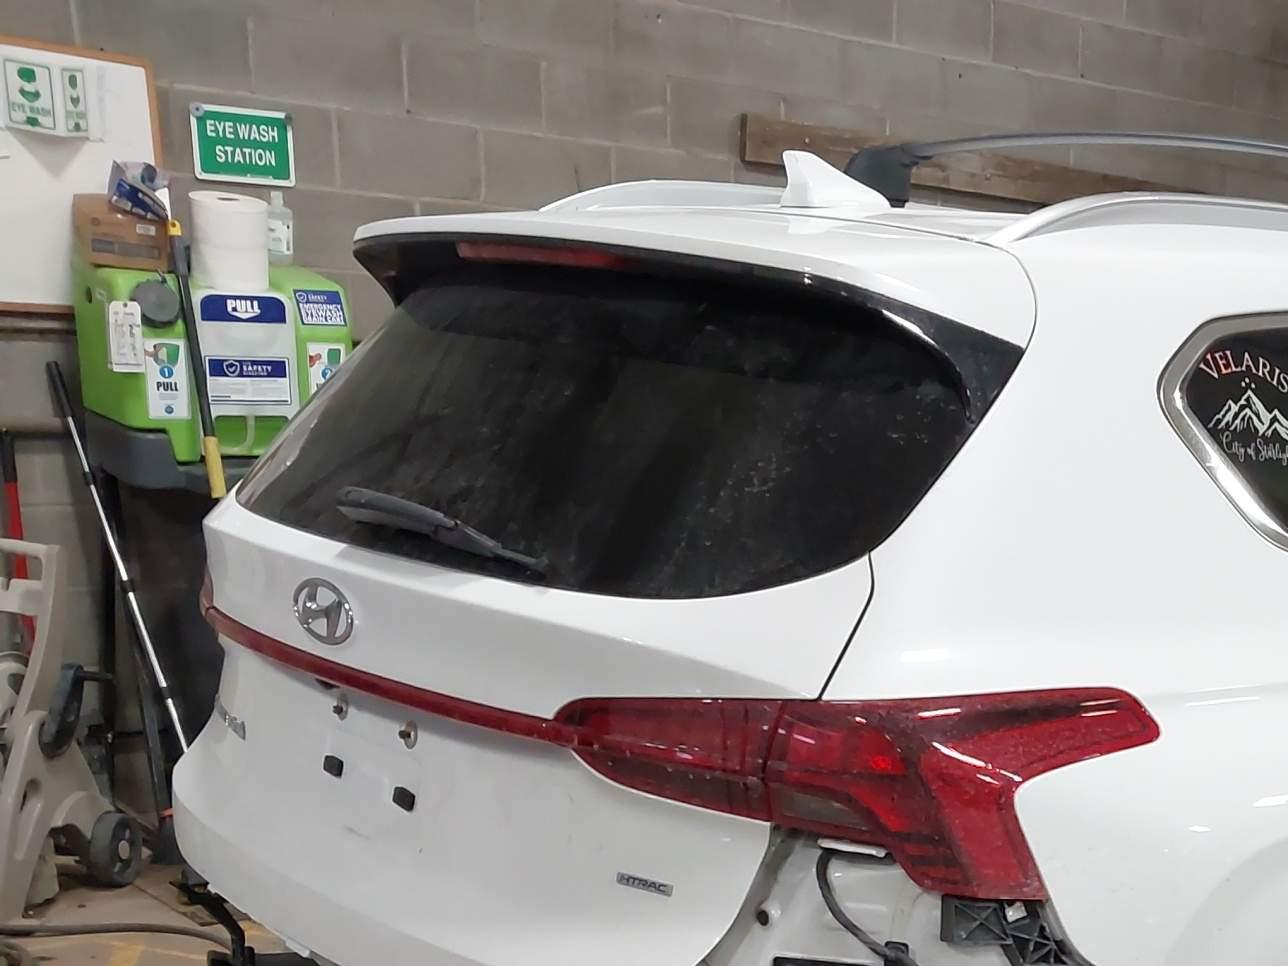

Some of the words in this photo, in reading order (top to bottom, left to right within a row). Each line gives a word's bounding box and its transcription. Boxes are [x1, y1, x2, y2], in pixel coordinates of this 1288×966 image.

[206, 120, 235, 139] EYE
[236, 122, 279, 143] WASH
[215, 145, 276, 167] STATION
[226, 299, 260, 313] PULL
[156, 381, 179, 392] PULL
[620, 873, 667, 893] HTRAC
